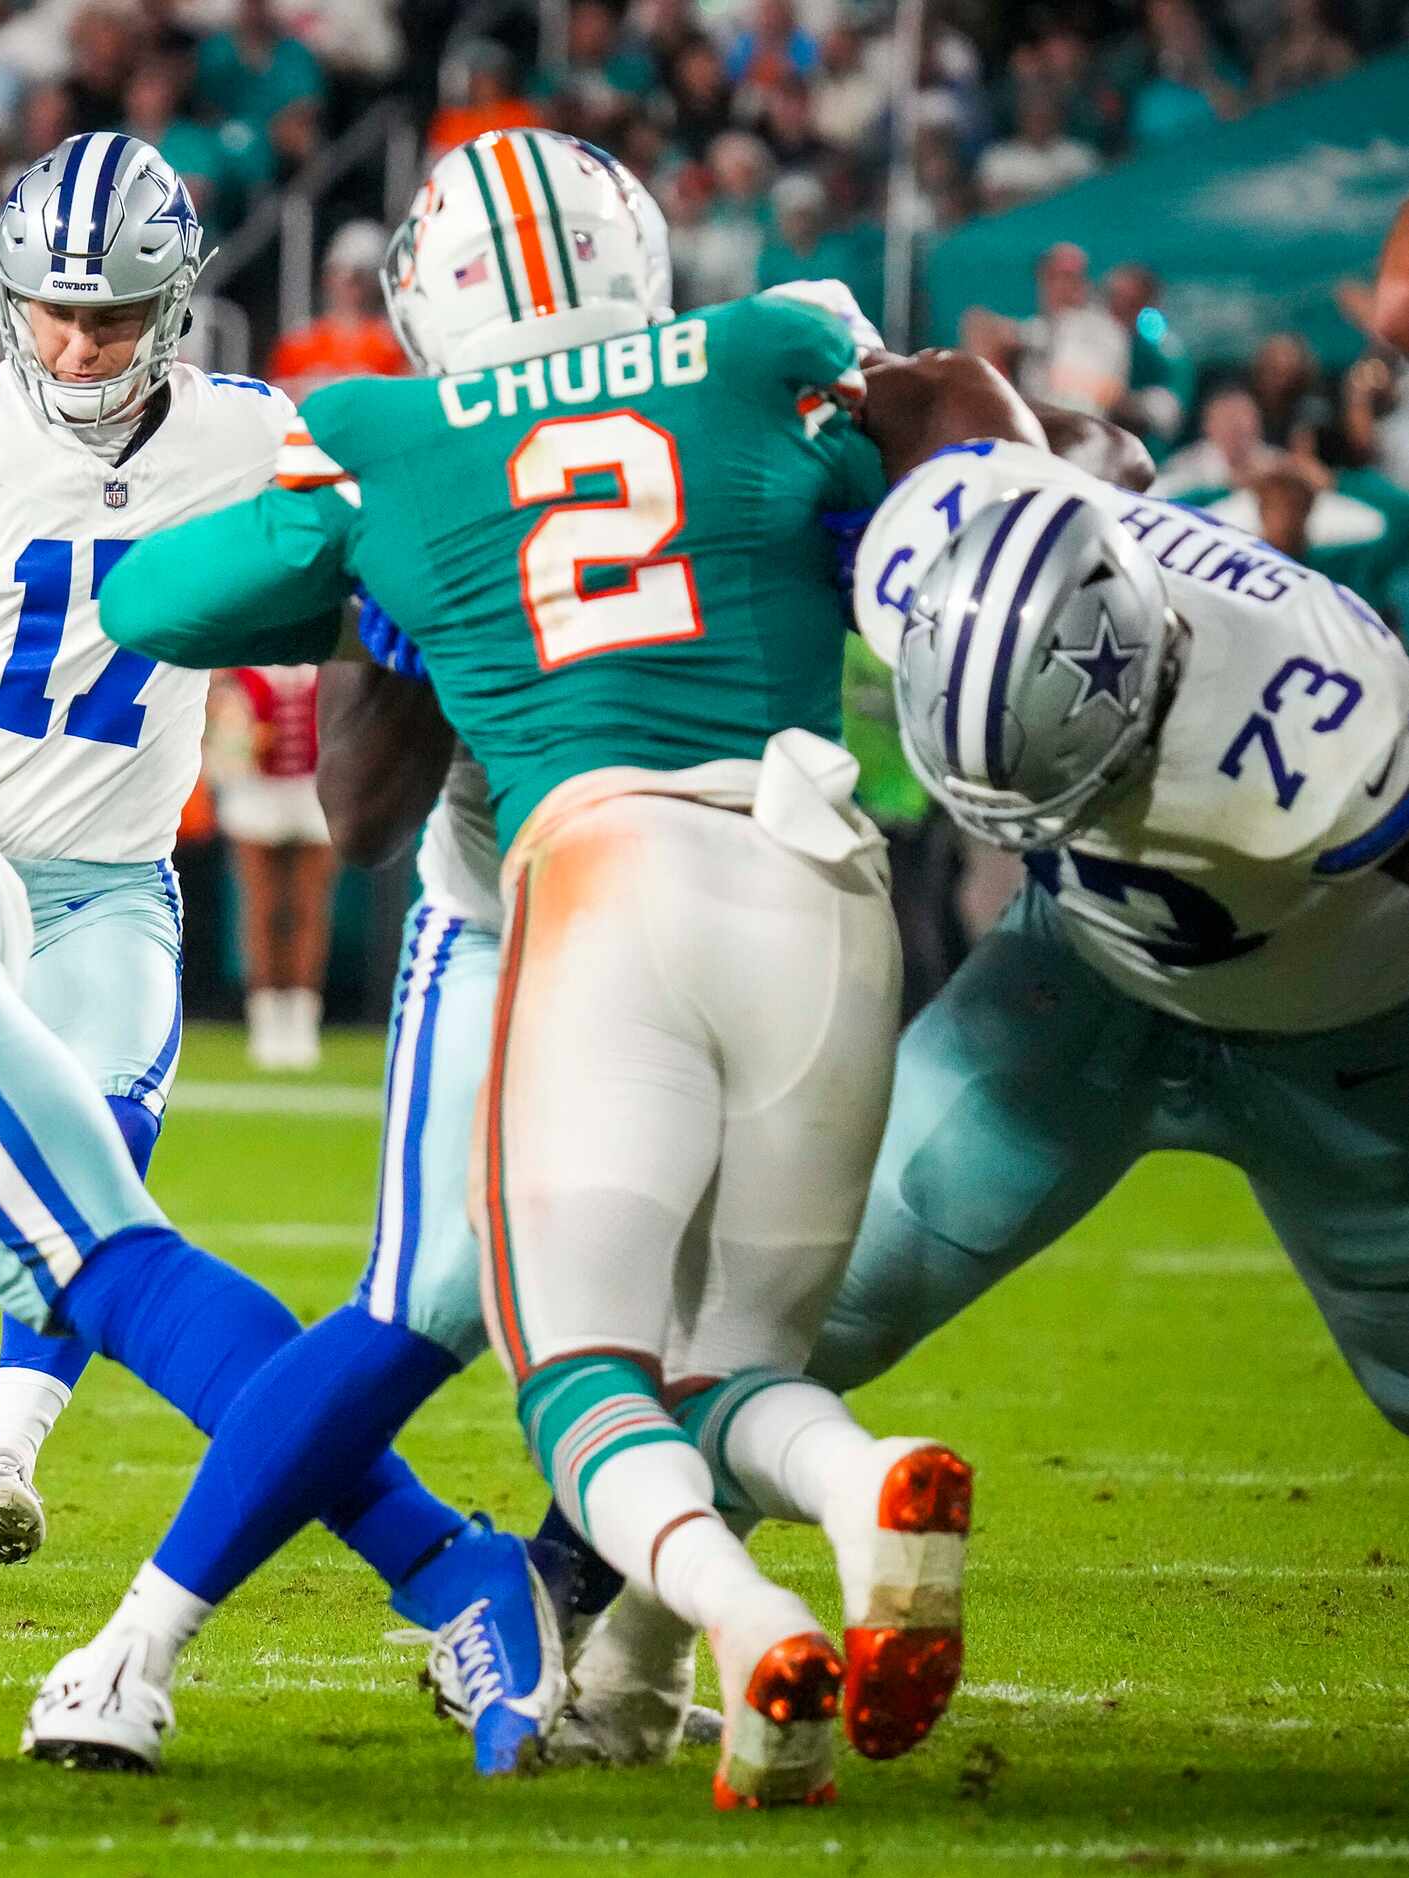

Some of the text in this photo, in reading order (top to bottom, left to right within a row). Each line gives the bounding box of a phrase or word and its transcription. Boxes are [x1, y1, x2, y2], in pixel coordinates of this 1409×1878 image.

[52, 280, 99, 292] COWBOYS
[438, 318, 708, 428] CHUBB
[505, 407, 706, 672] 2
[1218, 656, 1364, 812] 73
